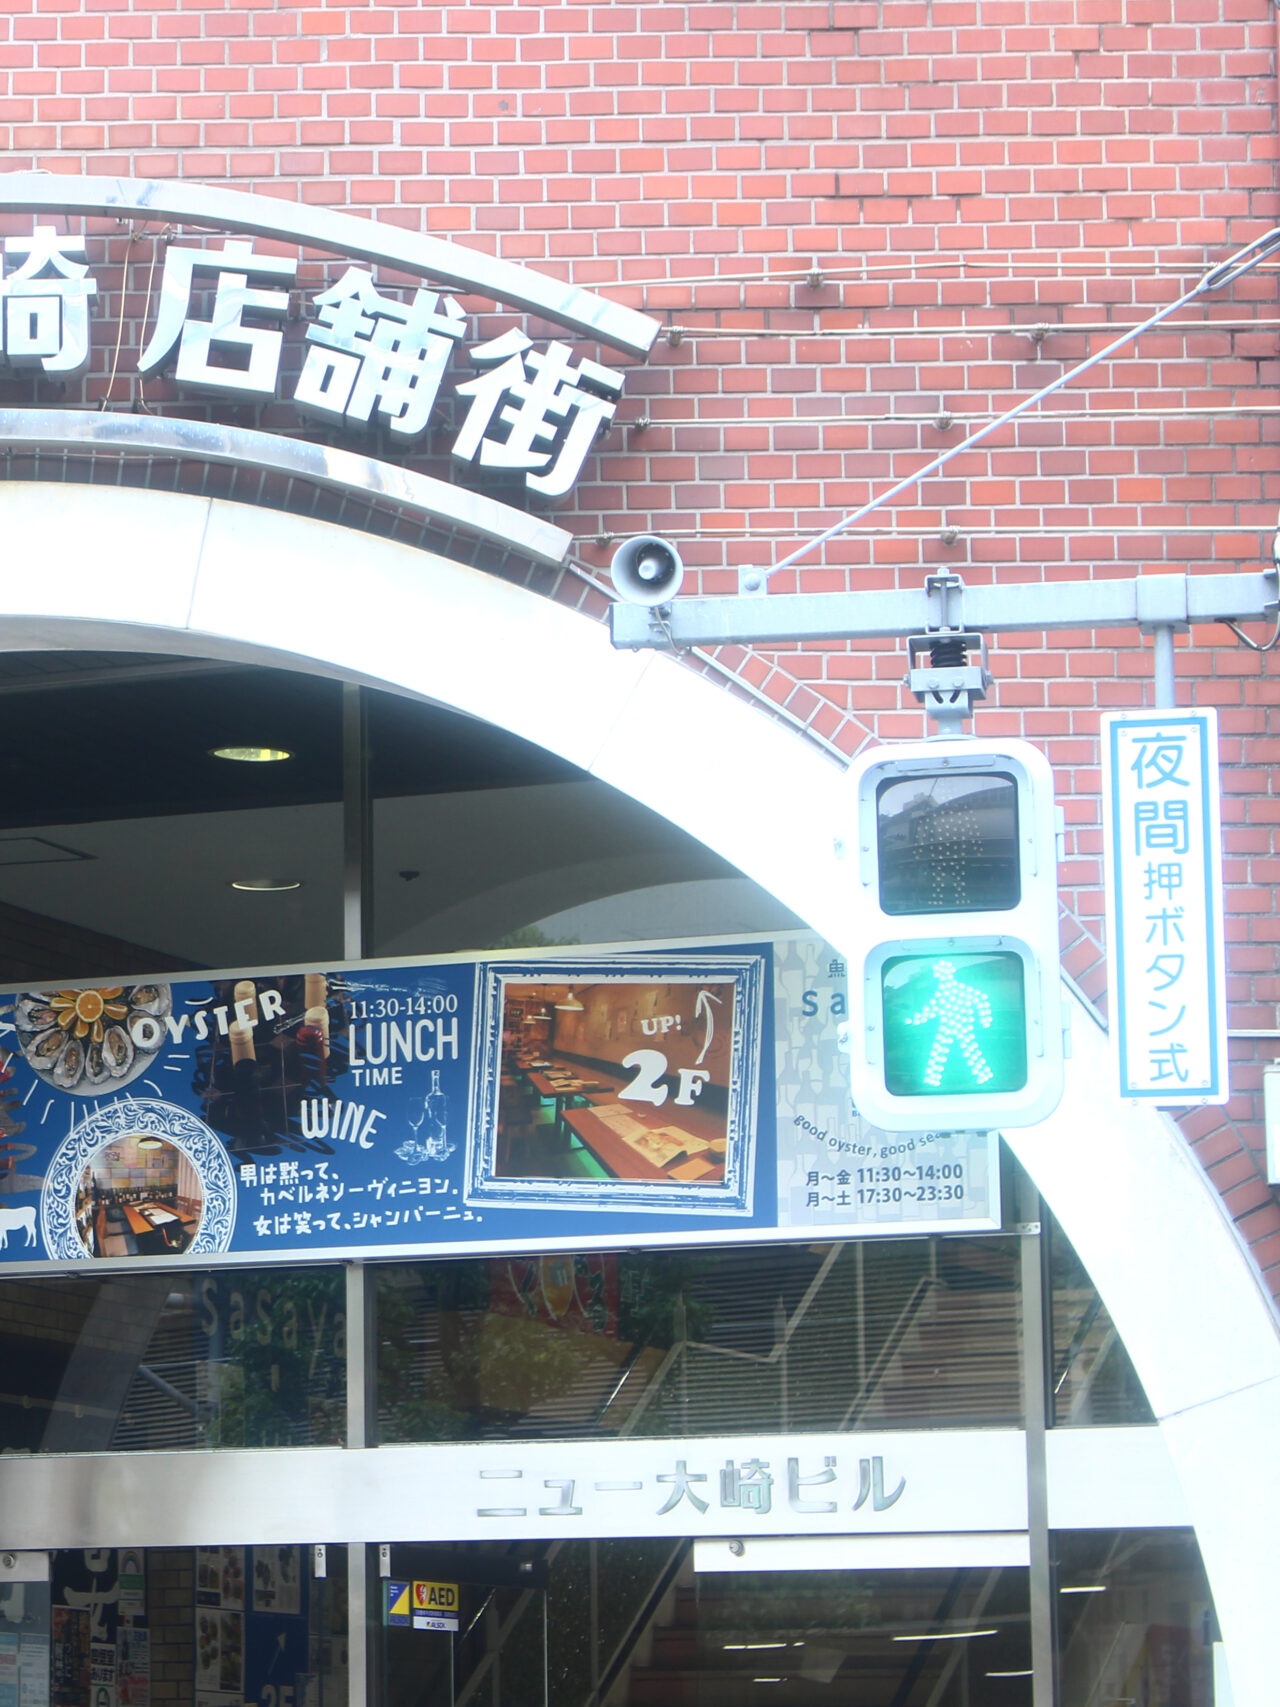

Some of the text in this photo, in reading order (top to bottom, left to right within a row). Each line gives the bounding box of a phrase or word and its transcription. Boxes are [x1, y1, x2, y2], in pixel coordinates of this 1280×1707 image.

[1131, 733, 1191, 1084] 夜間押ボタン式
[131, 989, 286, 1049] OYSTER
[349, 993, 458, 1019] 11:30-14:00
[349, 1017, 459, 1066] LUNCH
[641, 1015, 682, 1036] UP!
[352, 1066, 403, 1087] TIME
[620, 1049, 710, 1106] 2F
[300, 1097, 387, 1149] WINE
[794, 1114, 827, 1142] good
[828, 1137, 879, 1159] oyster,
[880, 1141, 916, 1159] good
[240, 1161, 339, 1188] 男は黙って、
[260, 1177, 458, 1206] カベルネソーヴィニヨン。
[252, 1206, 483, 1236] 女は笑って、シャンパーニュ。
[477, 1455, 906, 1517] ニュー大崎ビル
[428, 1587, 455, 1607] AED
